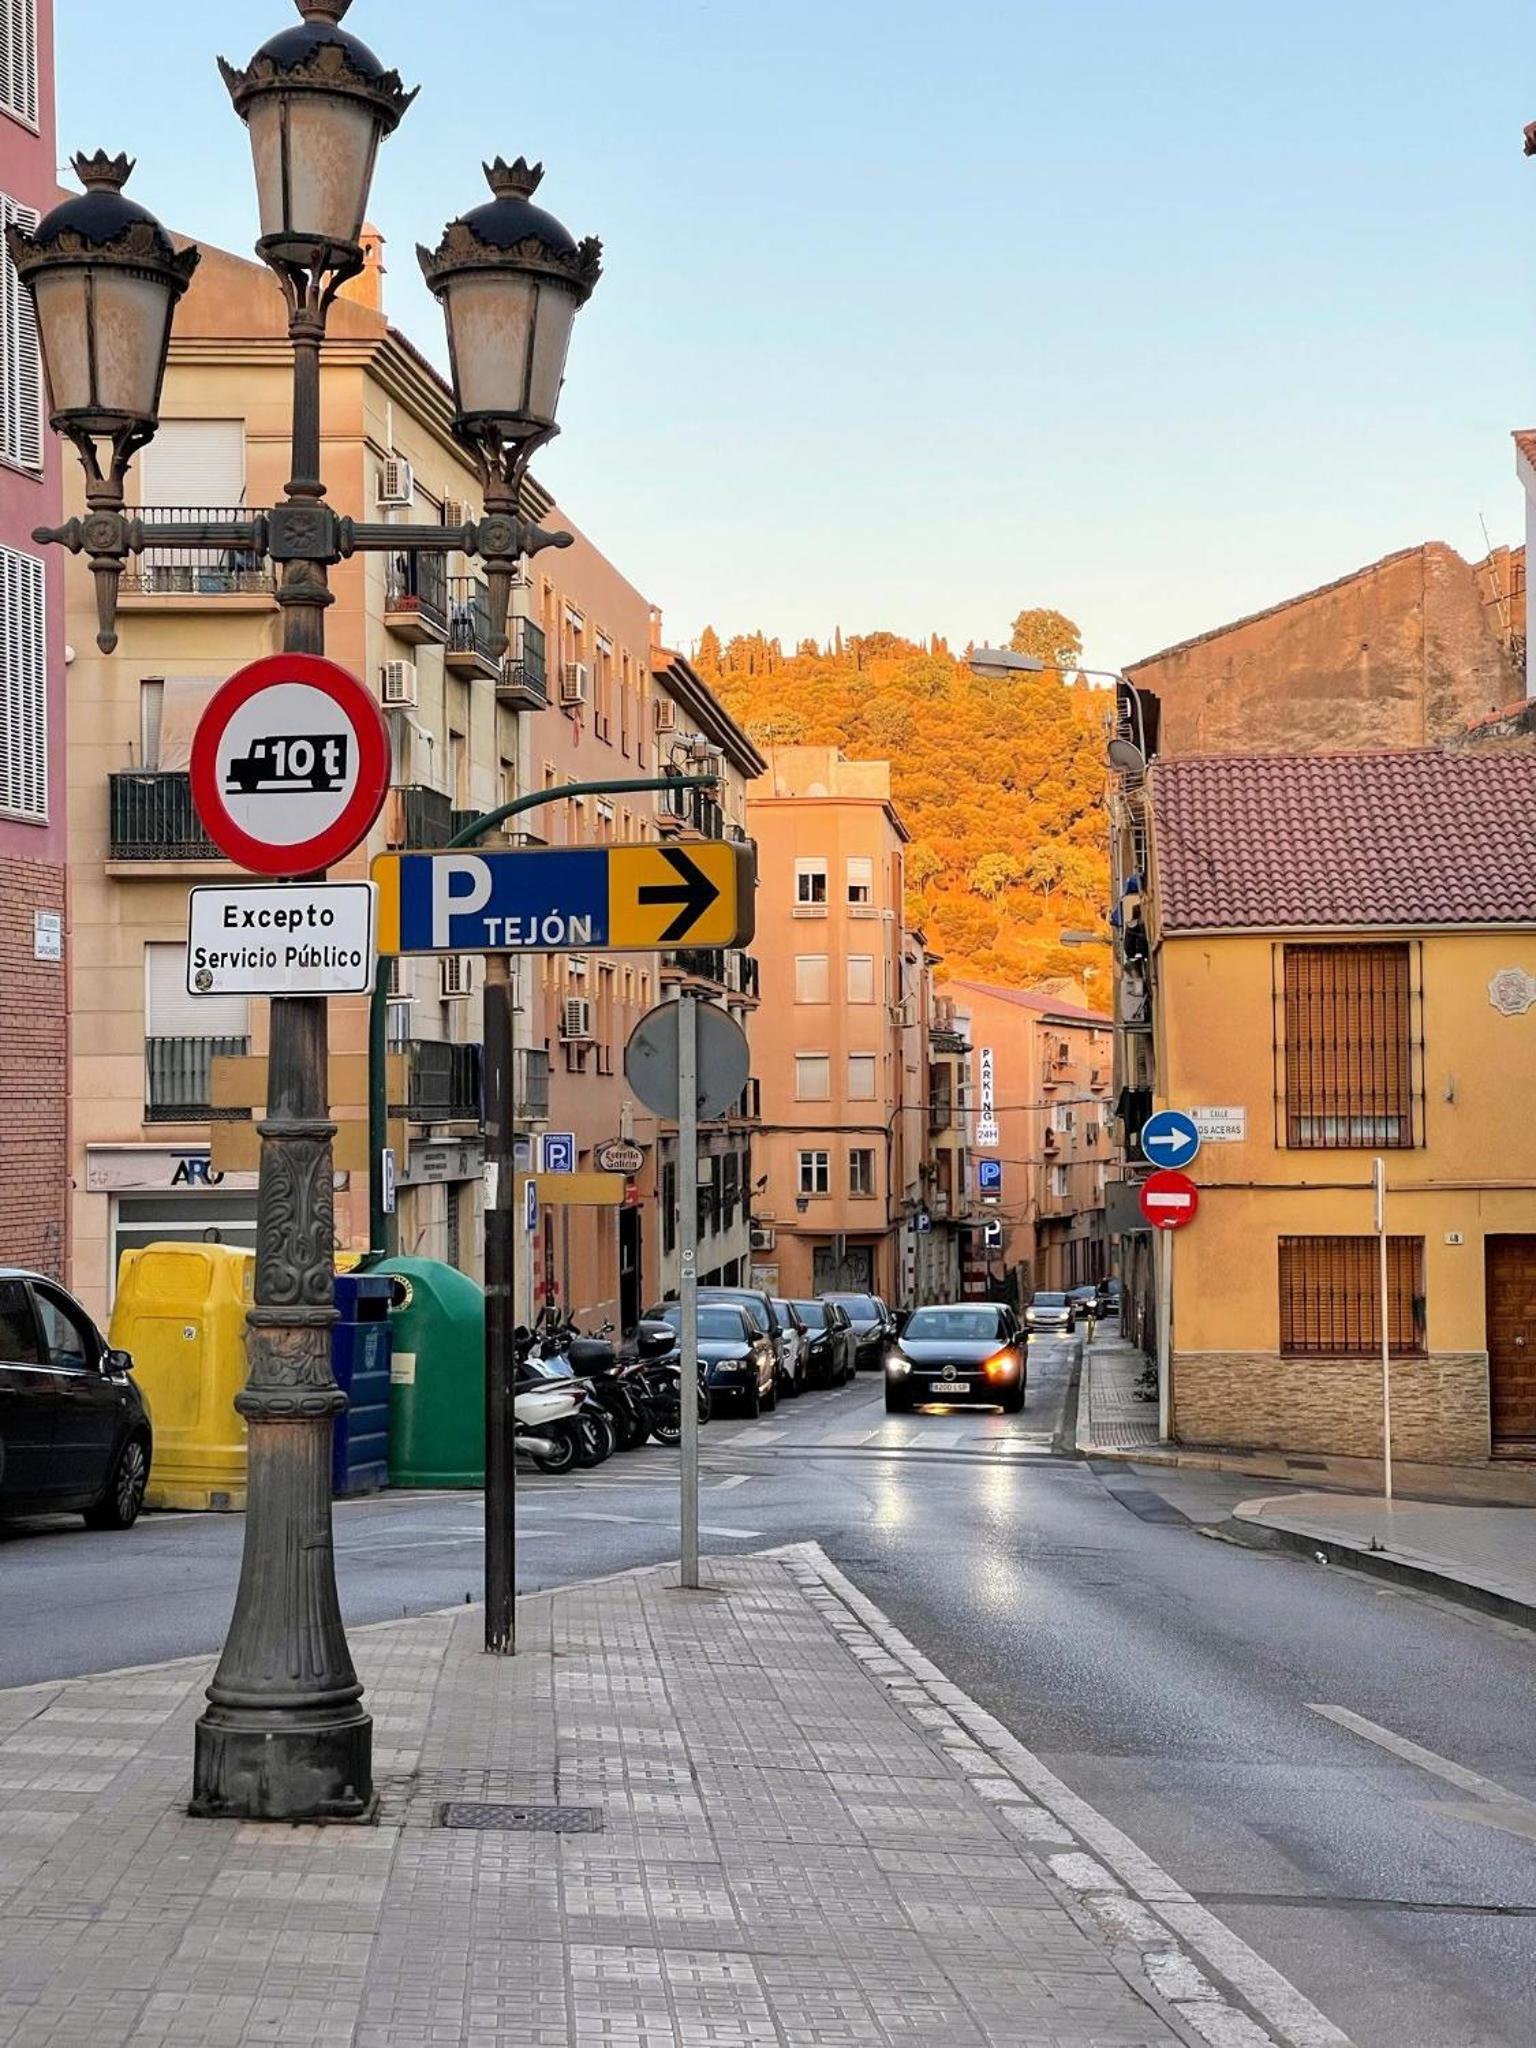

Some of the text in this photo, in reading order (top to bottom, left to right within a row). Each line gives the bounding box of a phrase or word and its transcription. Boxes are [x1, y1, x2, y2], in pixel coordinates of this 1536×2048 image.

[432, 855, 493, 948] P
[223, 904, 335, 933] Excepto
[483, 908, 592, 946] TEJÓN
[193, 943, 362, 969] Servicio Público
[982, 1049, 992, 1121] PARKING
[978, 1130, 997, 1139] 24H
[1210, 1126, 1241, 1134] ACERAS
[549, 1144, 566, 1168] P
[605, 1150, 639, 1161] Estrella
[981, 1162, 999, 1186] P
[919, 1214, 929, 1230] P
[985, 1219, 1001, 1244] P
